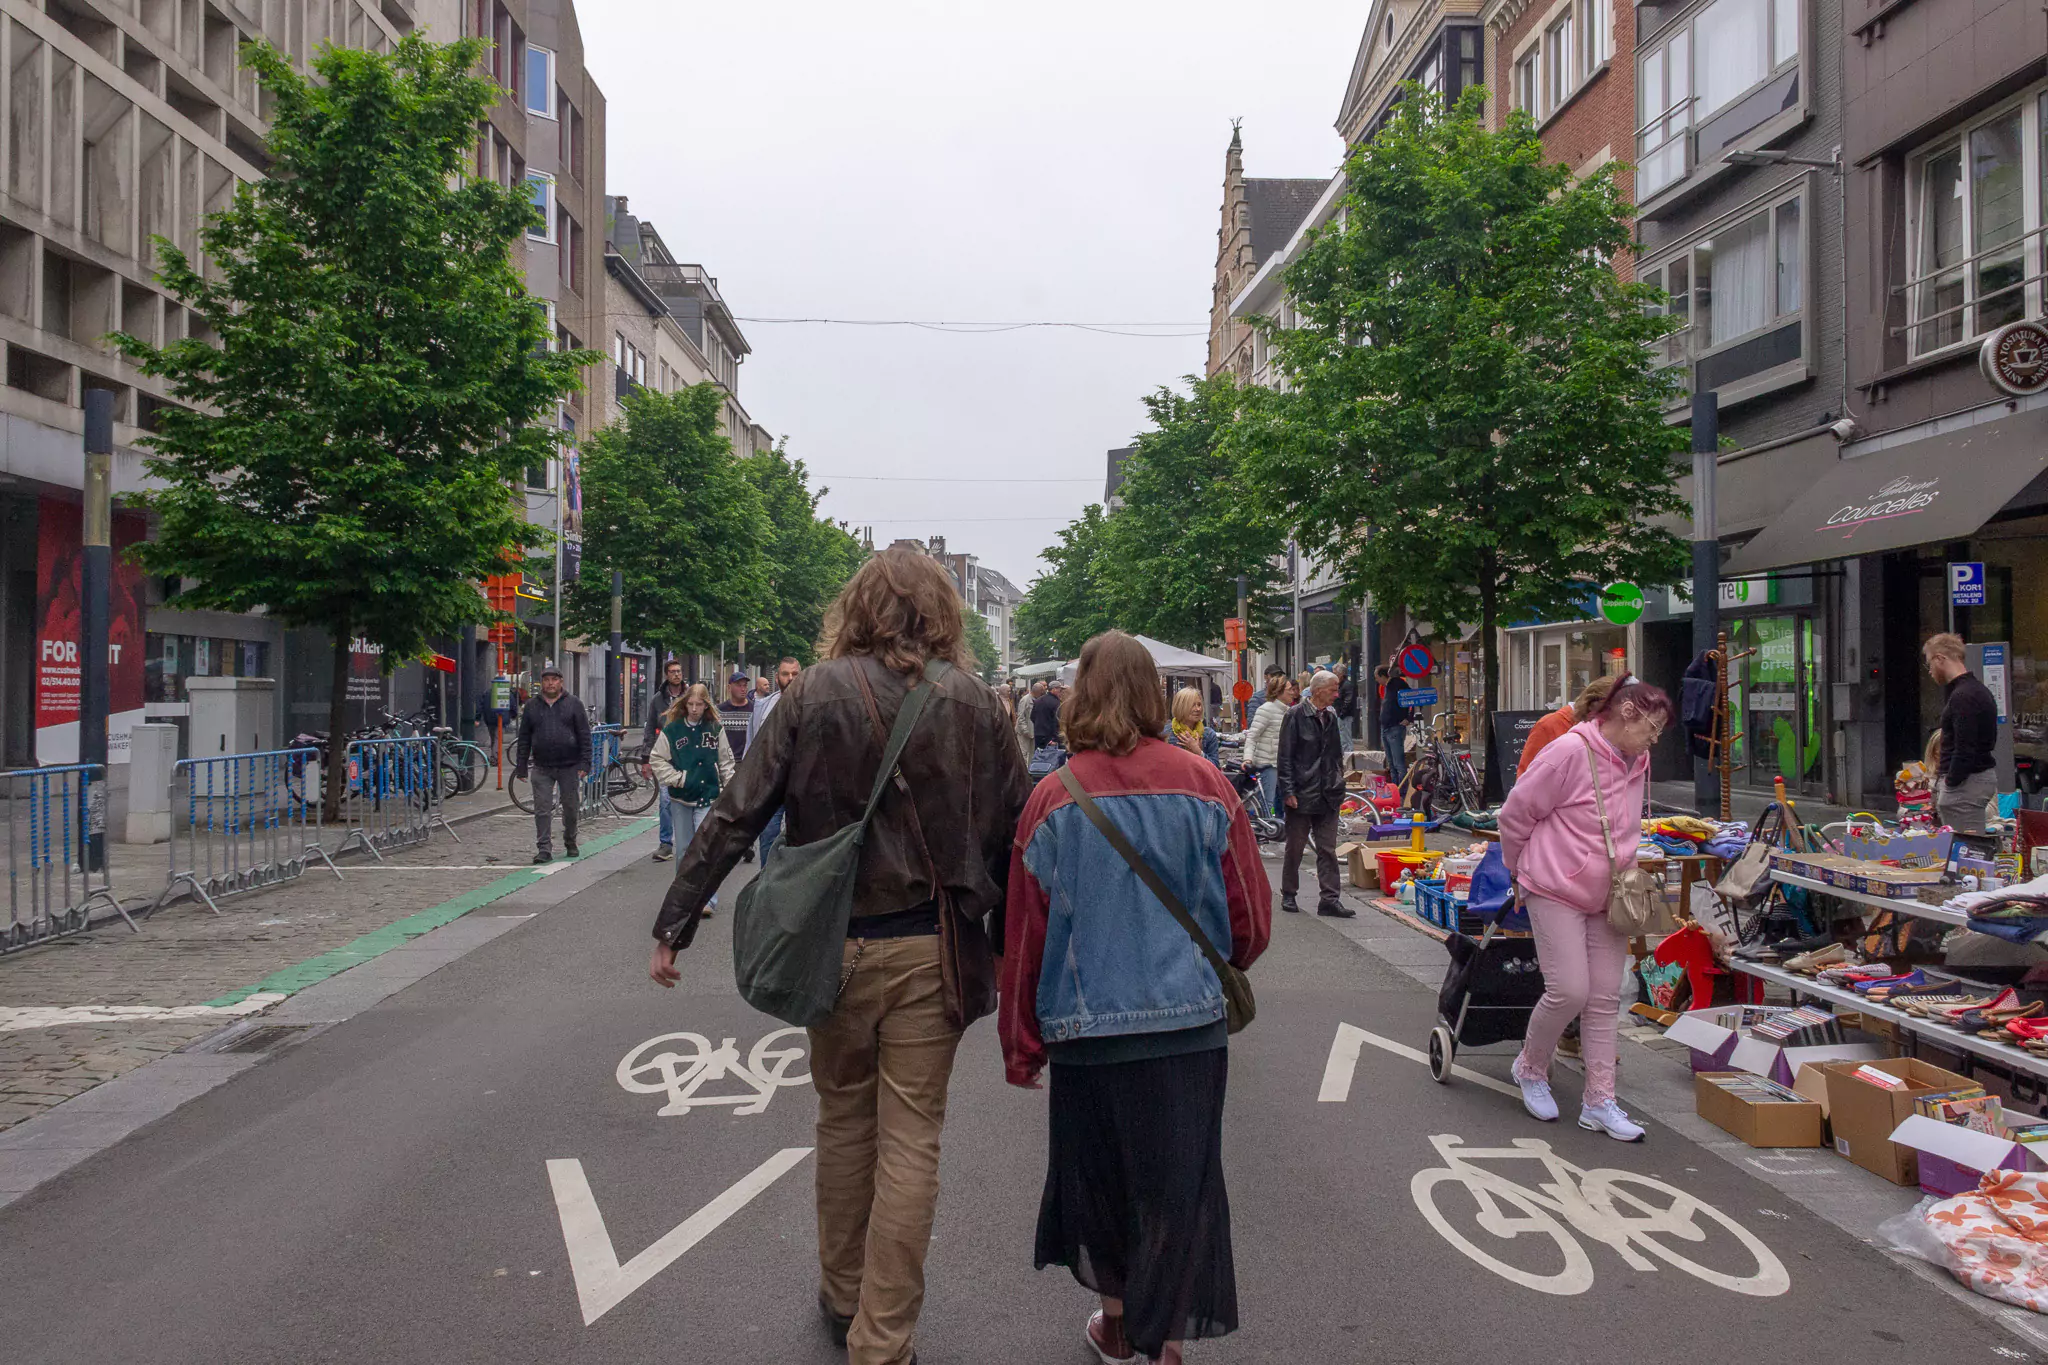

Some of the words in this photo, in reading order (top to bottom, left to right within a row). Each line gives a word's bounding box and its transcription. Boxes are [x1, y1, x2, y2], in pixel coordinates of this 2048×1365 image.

[1827, 491, 1940, 524] Courcelles
[1952, 565, 1974, 592] P
[1959, 583, 1982, 592] KOR1
[42, 640, 77, 662] FOR
